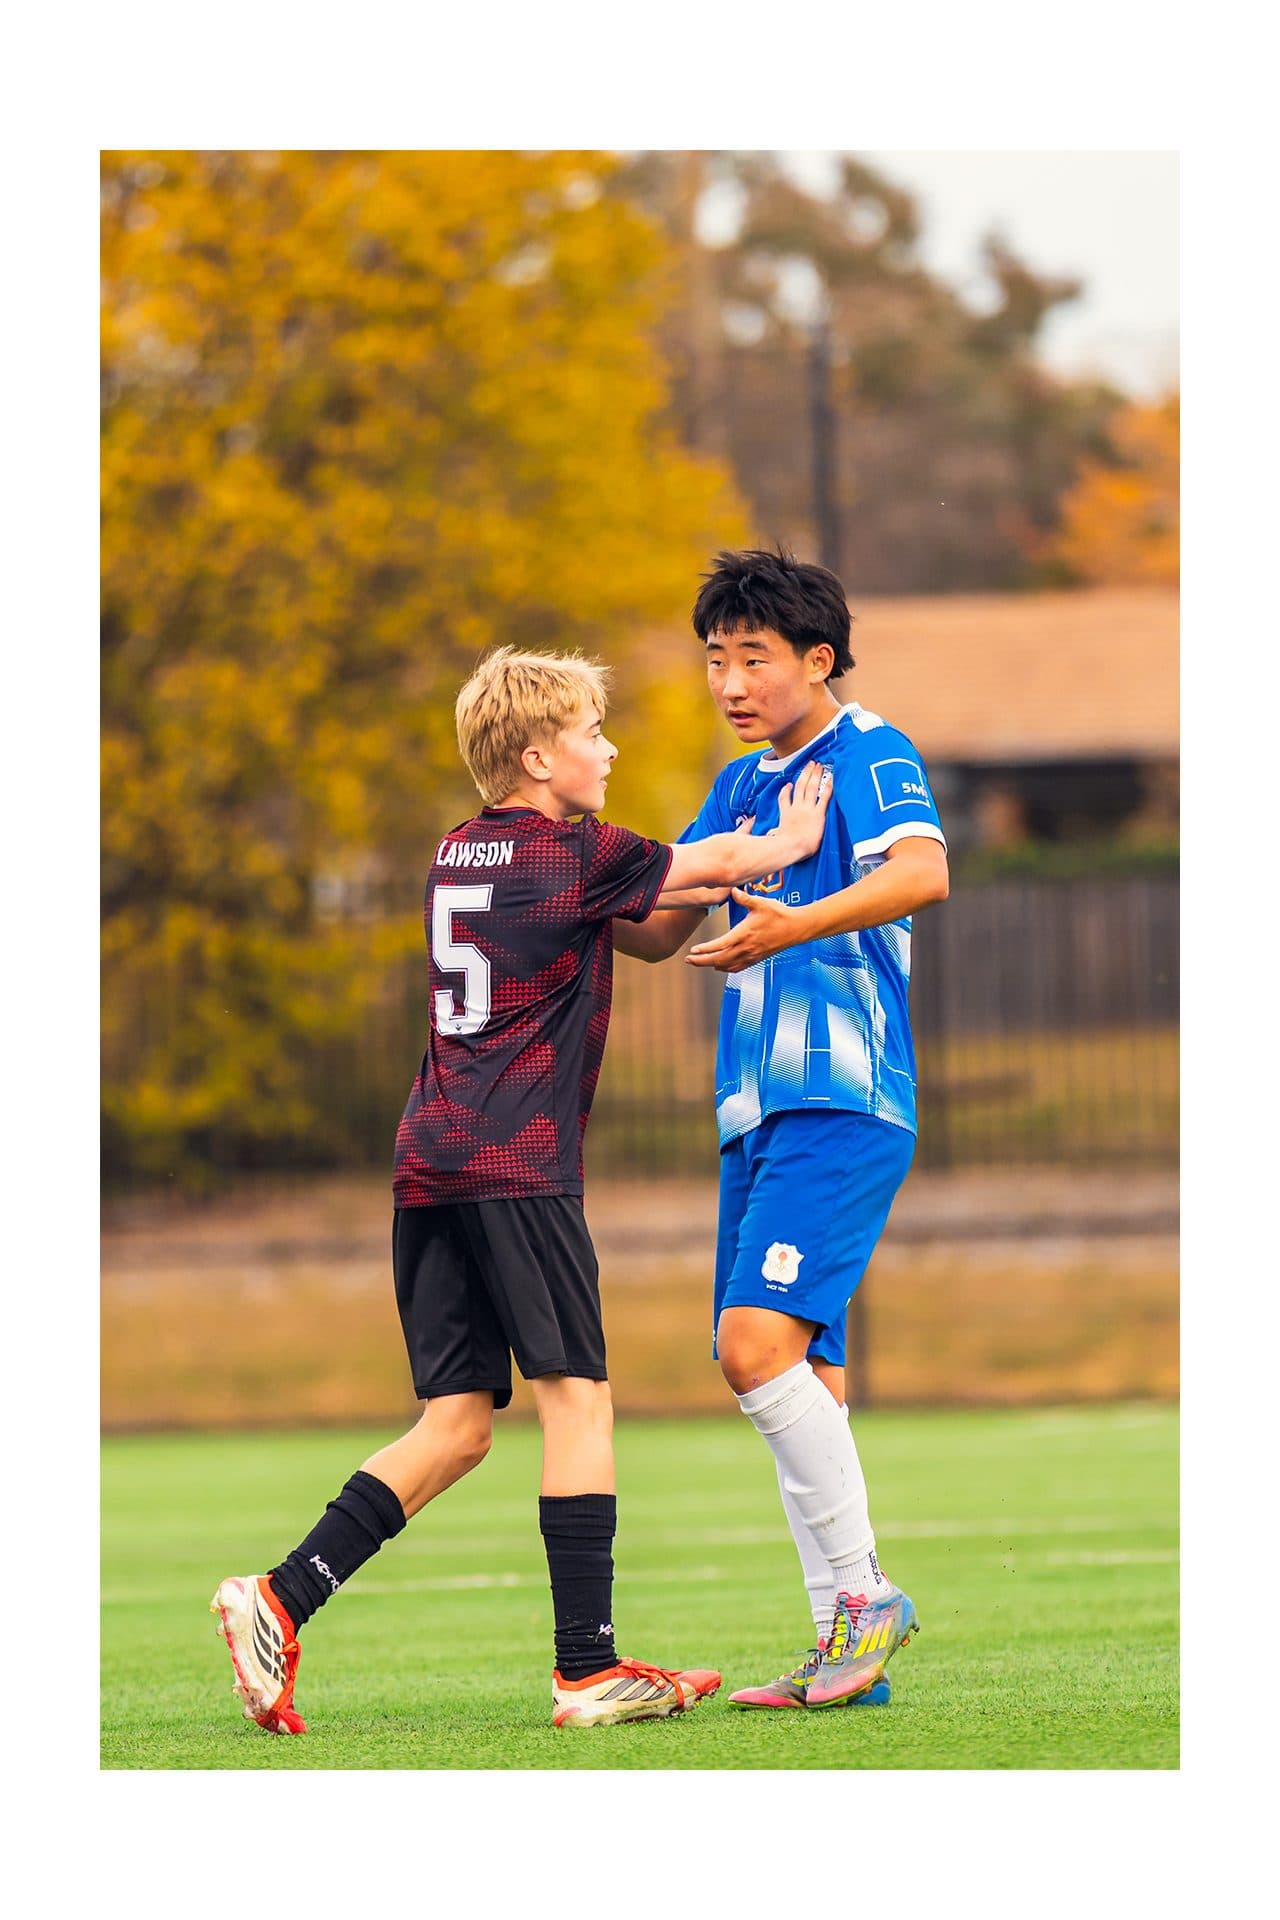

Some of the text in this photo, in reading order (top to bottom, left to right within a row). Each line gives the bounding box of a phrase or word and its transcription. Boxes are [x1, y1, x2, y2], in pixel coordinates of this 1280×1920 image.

[901, 782, 929, 799] 5M
[435, 840, 515, 868] LAWSON
[432, 884, 494, 1036] 5
